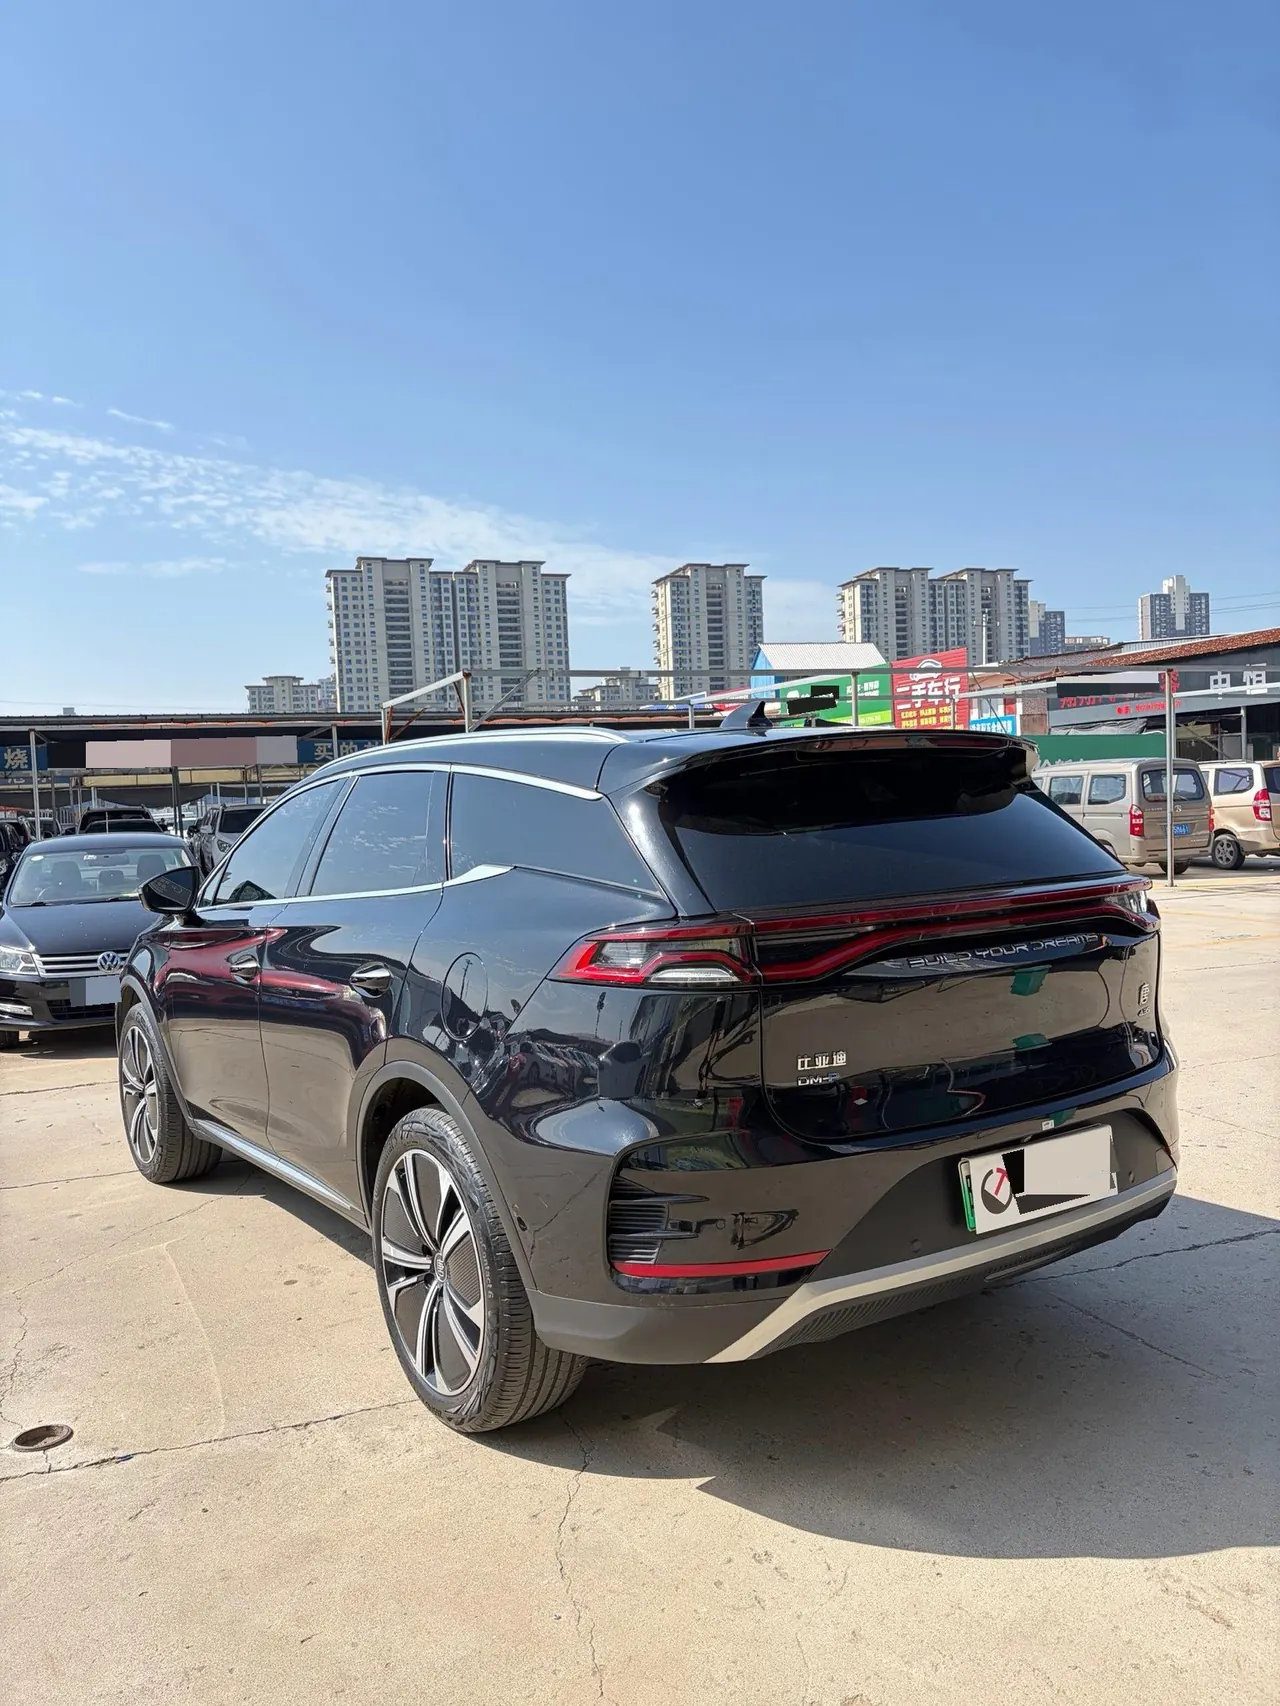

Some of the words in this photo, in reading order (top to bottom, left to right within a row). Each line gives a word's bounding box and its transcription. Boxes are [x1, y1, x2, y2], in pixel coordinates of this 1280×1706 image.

[896, 677, 961, 710] 二手车行
[314, 741, 379, 760] 买的
[908, 951, 972, 968] BUILD
[974, 944, 1029, 958] YOUR
[1033, 933, 1099, 951] DREAMS
[797, 1051, 847, 1070] 比亚迪
